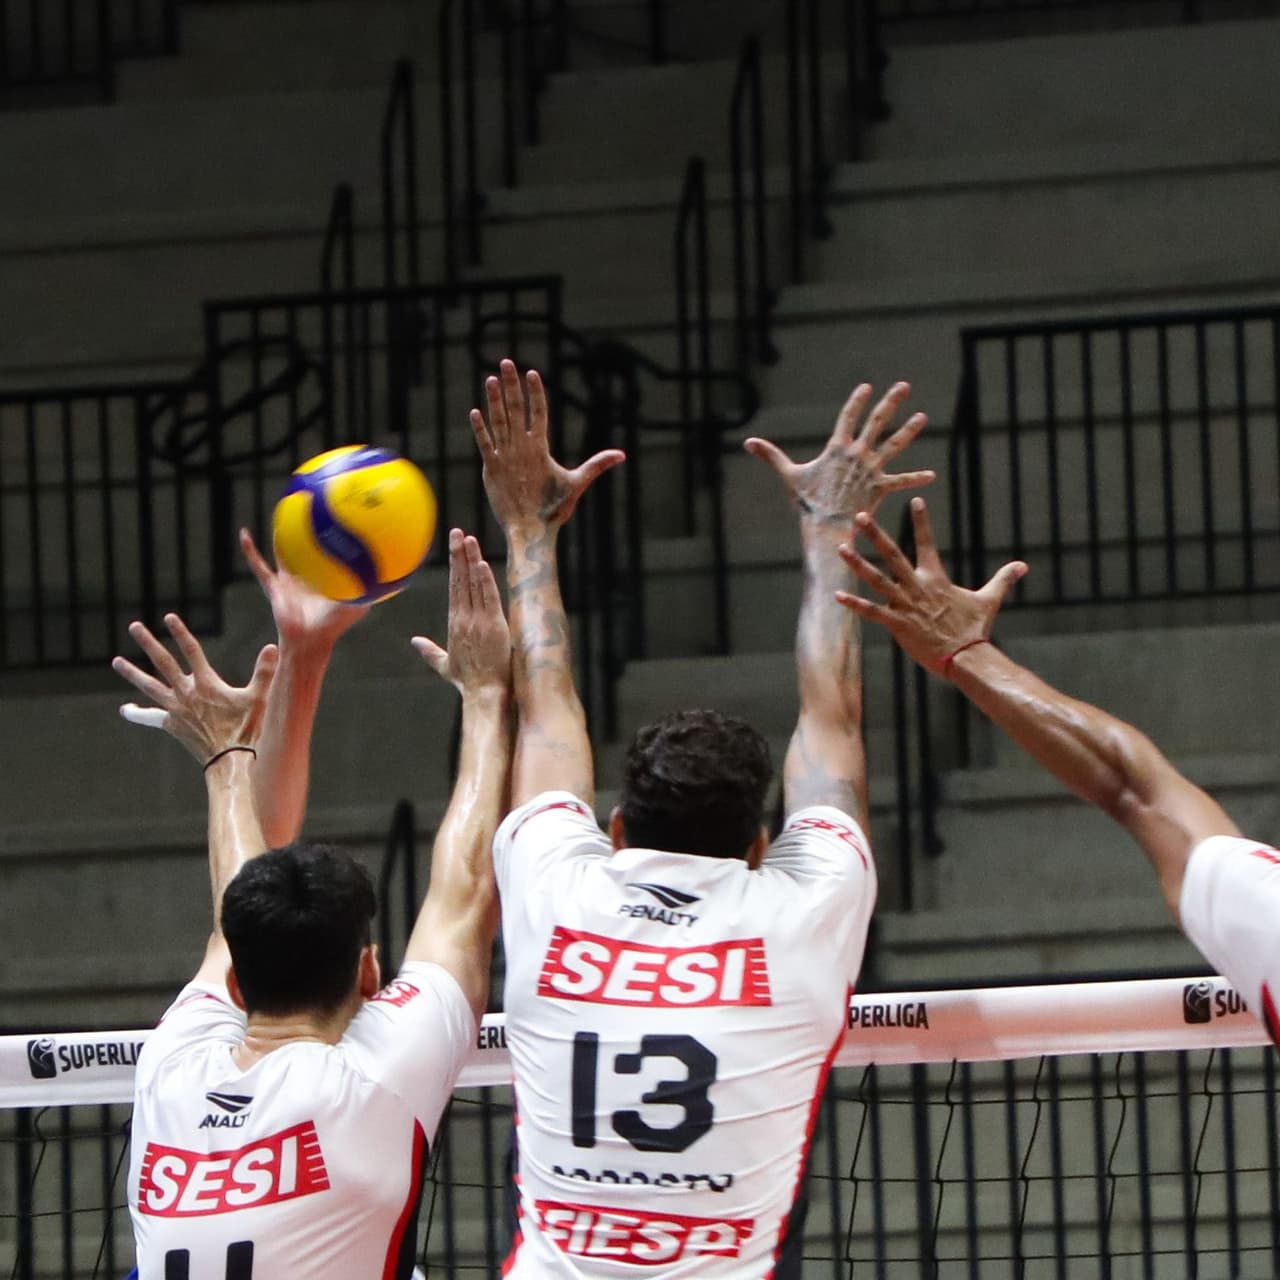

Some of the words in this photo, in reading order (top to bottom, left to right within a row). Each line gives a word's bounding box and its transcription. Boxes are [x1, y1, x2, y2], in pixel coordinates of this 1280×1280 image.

[618, 903, 699, 927] PENALTY
[549, 940, 747, 1004] SESI
[570, 1031, 718, 1153] 13
[146, 1136, 300, 1212] SESI
